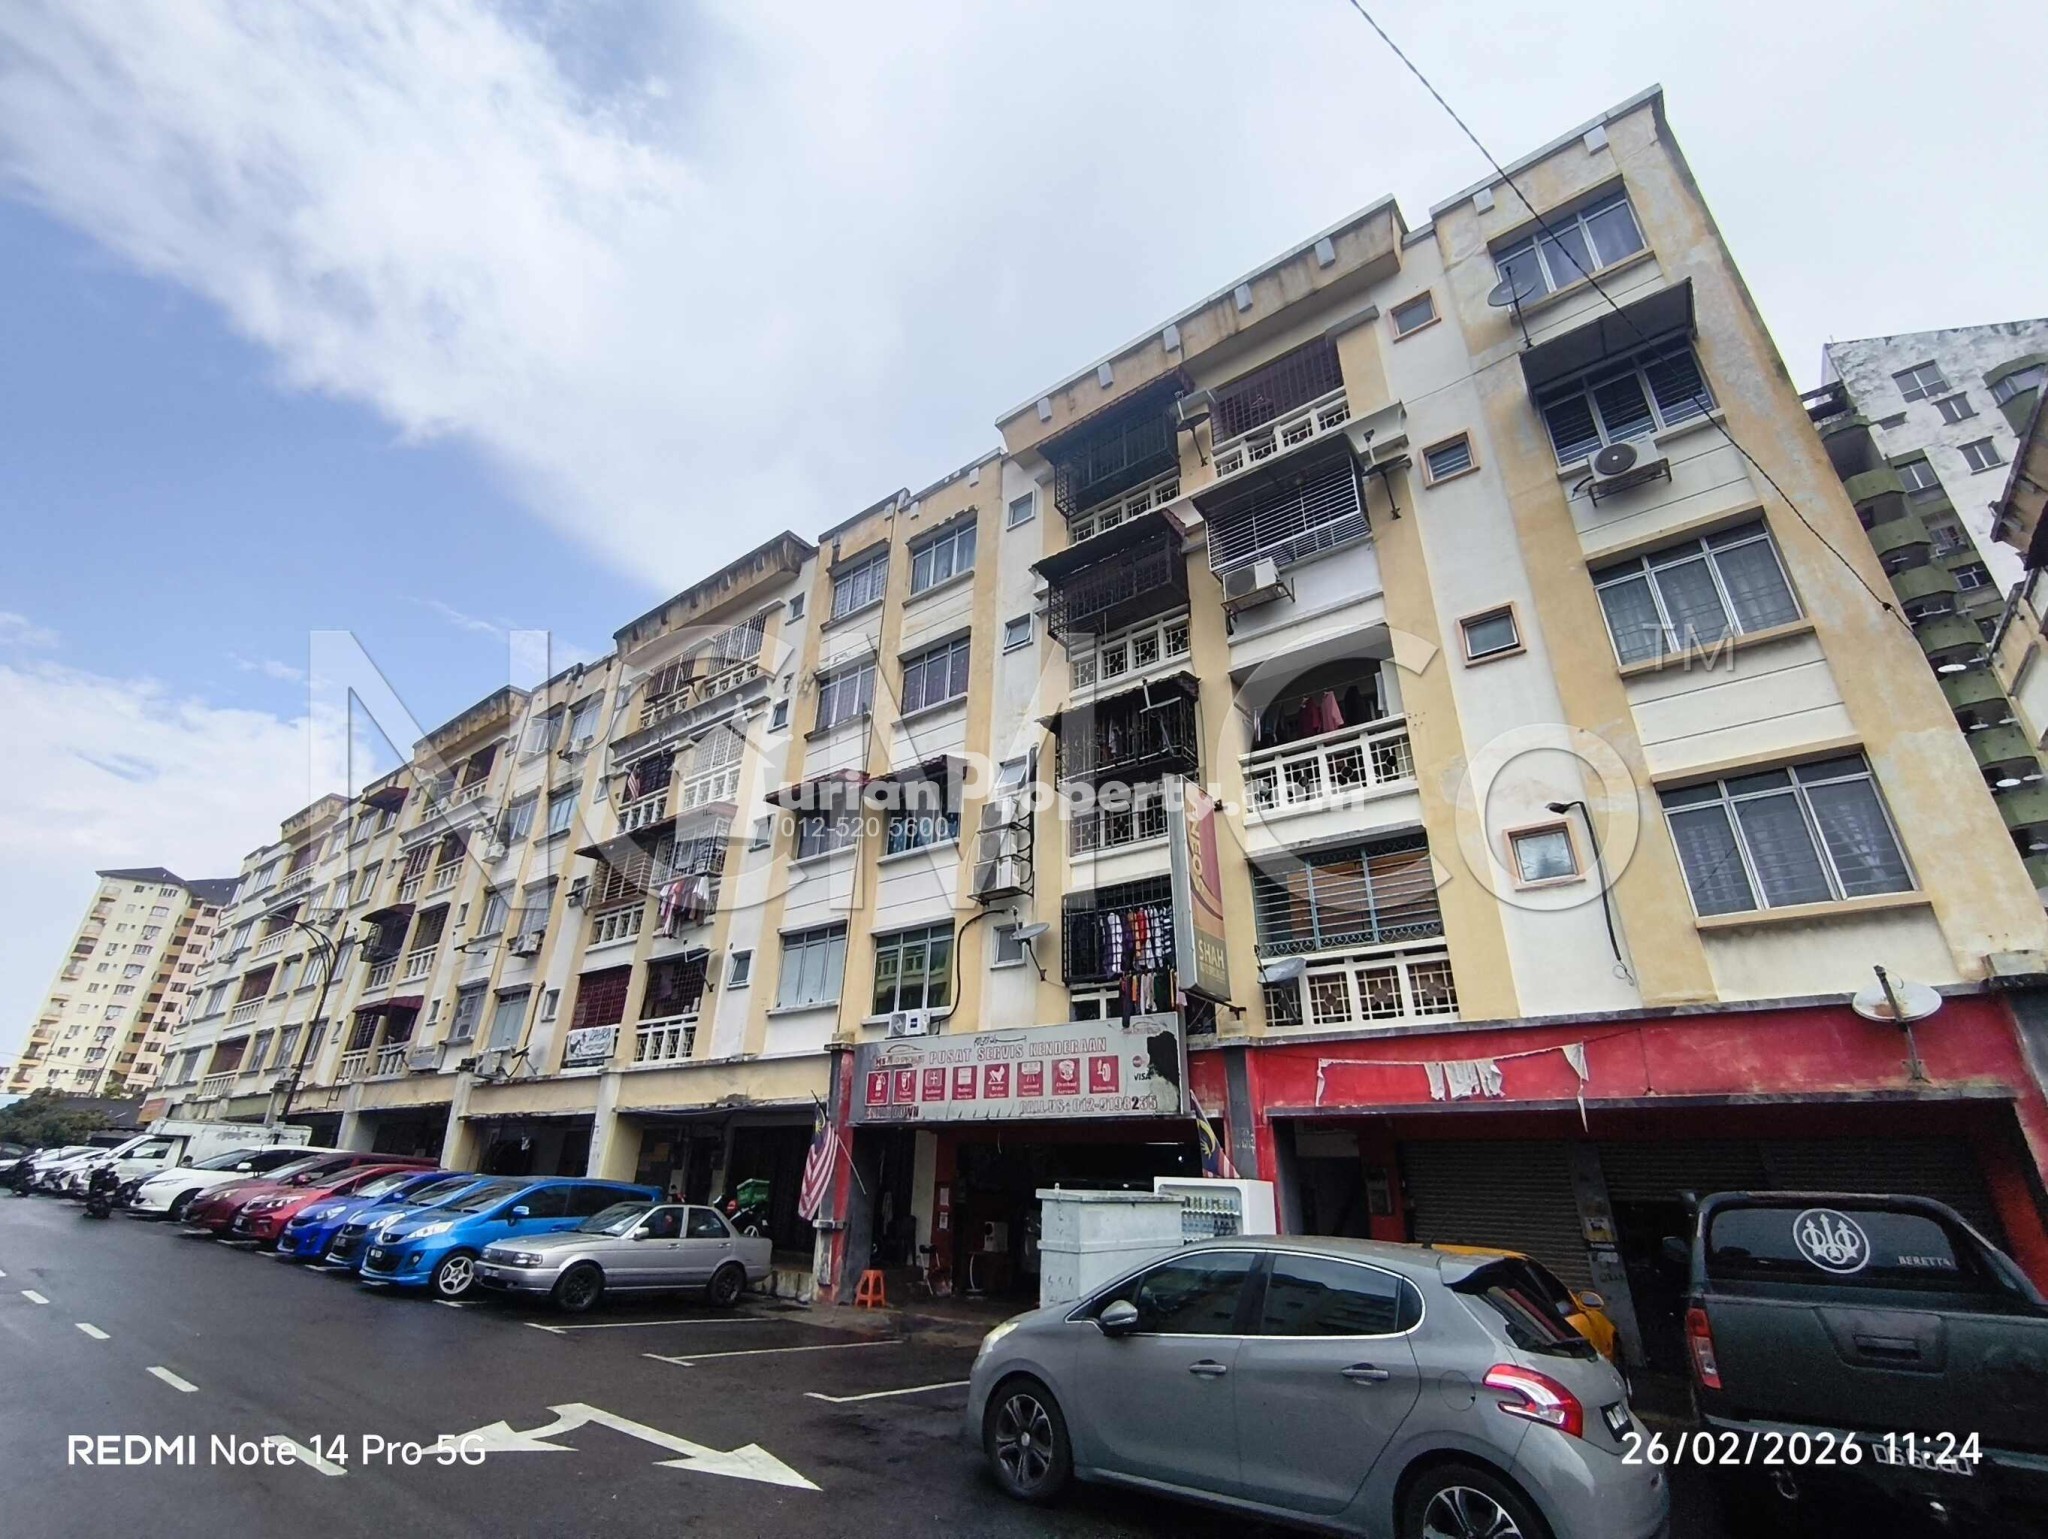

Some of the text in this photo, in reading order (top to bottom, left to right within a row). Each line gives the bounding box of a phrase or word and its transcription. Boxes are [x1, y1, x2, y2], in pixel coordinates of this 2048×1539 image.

[1198, 939, 1225, 970] SHAH
[929, 1048, 972, 1065] PUSAT
[976, 1043, 1024, 1062] SERVIS
[1028, 1036, 1107, 1058] KENDERAAN
[1897, 1255, 1953, 1267] BERETTA
